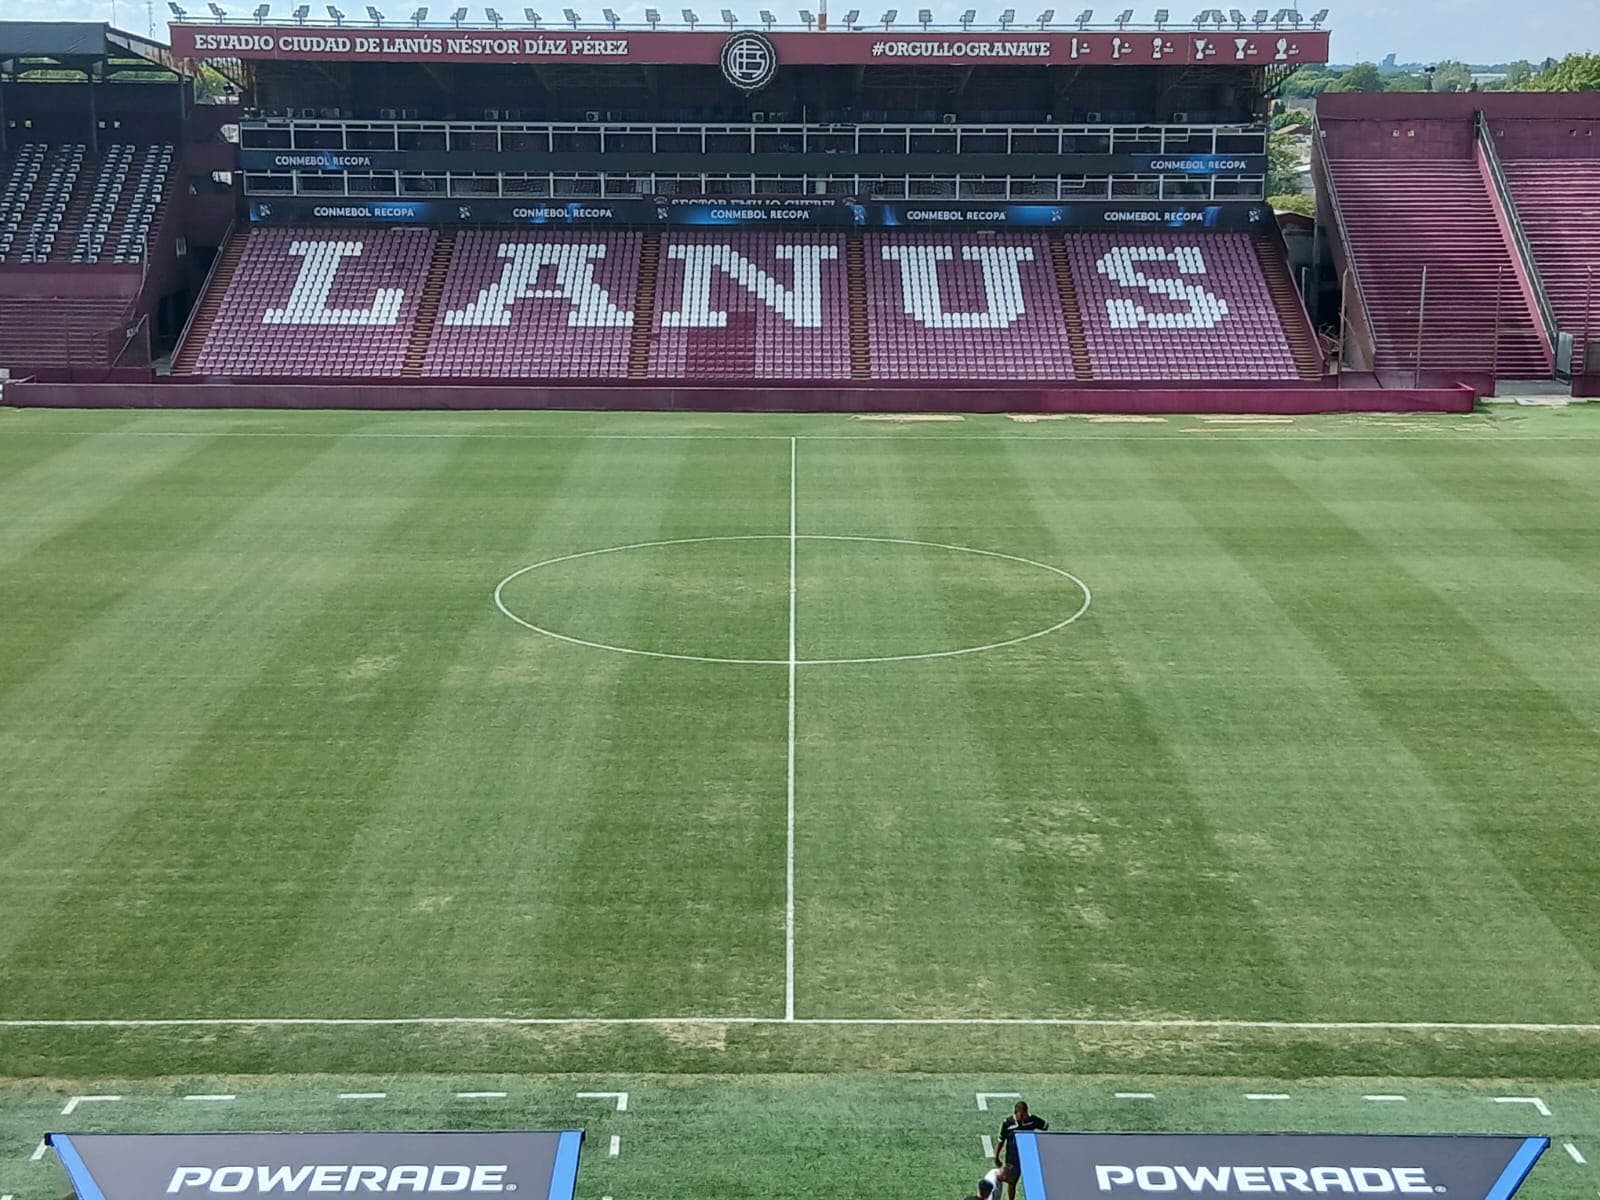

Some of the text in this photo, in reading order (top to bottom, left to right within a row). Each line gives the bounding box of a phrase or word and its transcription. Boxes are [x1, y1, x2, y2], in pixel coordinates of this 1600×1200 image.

[195, 34, 628, 56] ESTADIO CIUDAD DE LANÚS NÉSTOR DÍAZ PÉREZ
[872, 41, 1050, 57] #ORGULLOGRANATE
[275, 156, 371, 166] CONMEBOL RECOPA
[1150, 160, 1247, 170] CONMEBOL RECOPA
[314, 207, 415, 217] CONMEBOL RECOPA
[513, 208, 612, 218] CONMEBOL RECOPA
[711, 210, 809, 219] CONMEBOL RECOPA
[907, 210, 1005, 220] CONMEBOL RECOPA
[1104, 211, 1203, 221] CONMEBOL RECOPA
[262, 240, 1228, 330] LANUS
